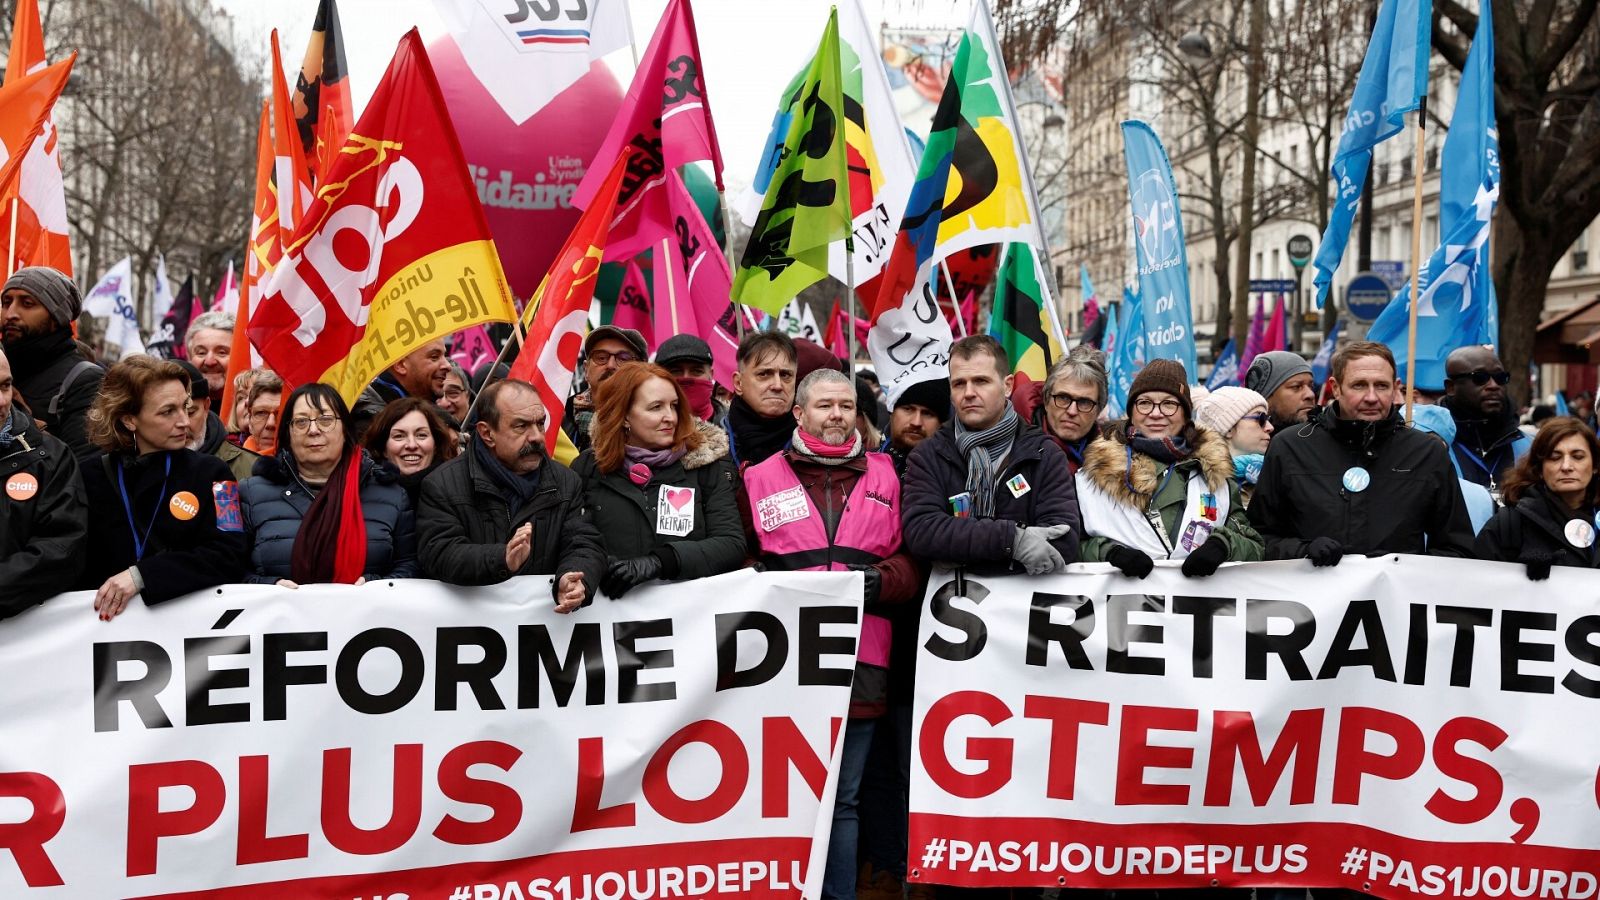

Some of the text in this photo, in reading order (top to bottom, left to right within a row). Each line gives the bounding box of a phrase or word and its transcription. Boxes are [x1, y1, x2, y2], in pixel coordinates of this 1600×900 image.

[93, 606, 859, 732] RÉFORME DE
[924, 580, 991, 661] S
[126, 740, 524, 877] PLUS
[919, 690, 1541, 844] GTEMPS,
[921, 837, 1308, 874] #PAS1JOURDEPLUS
